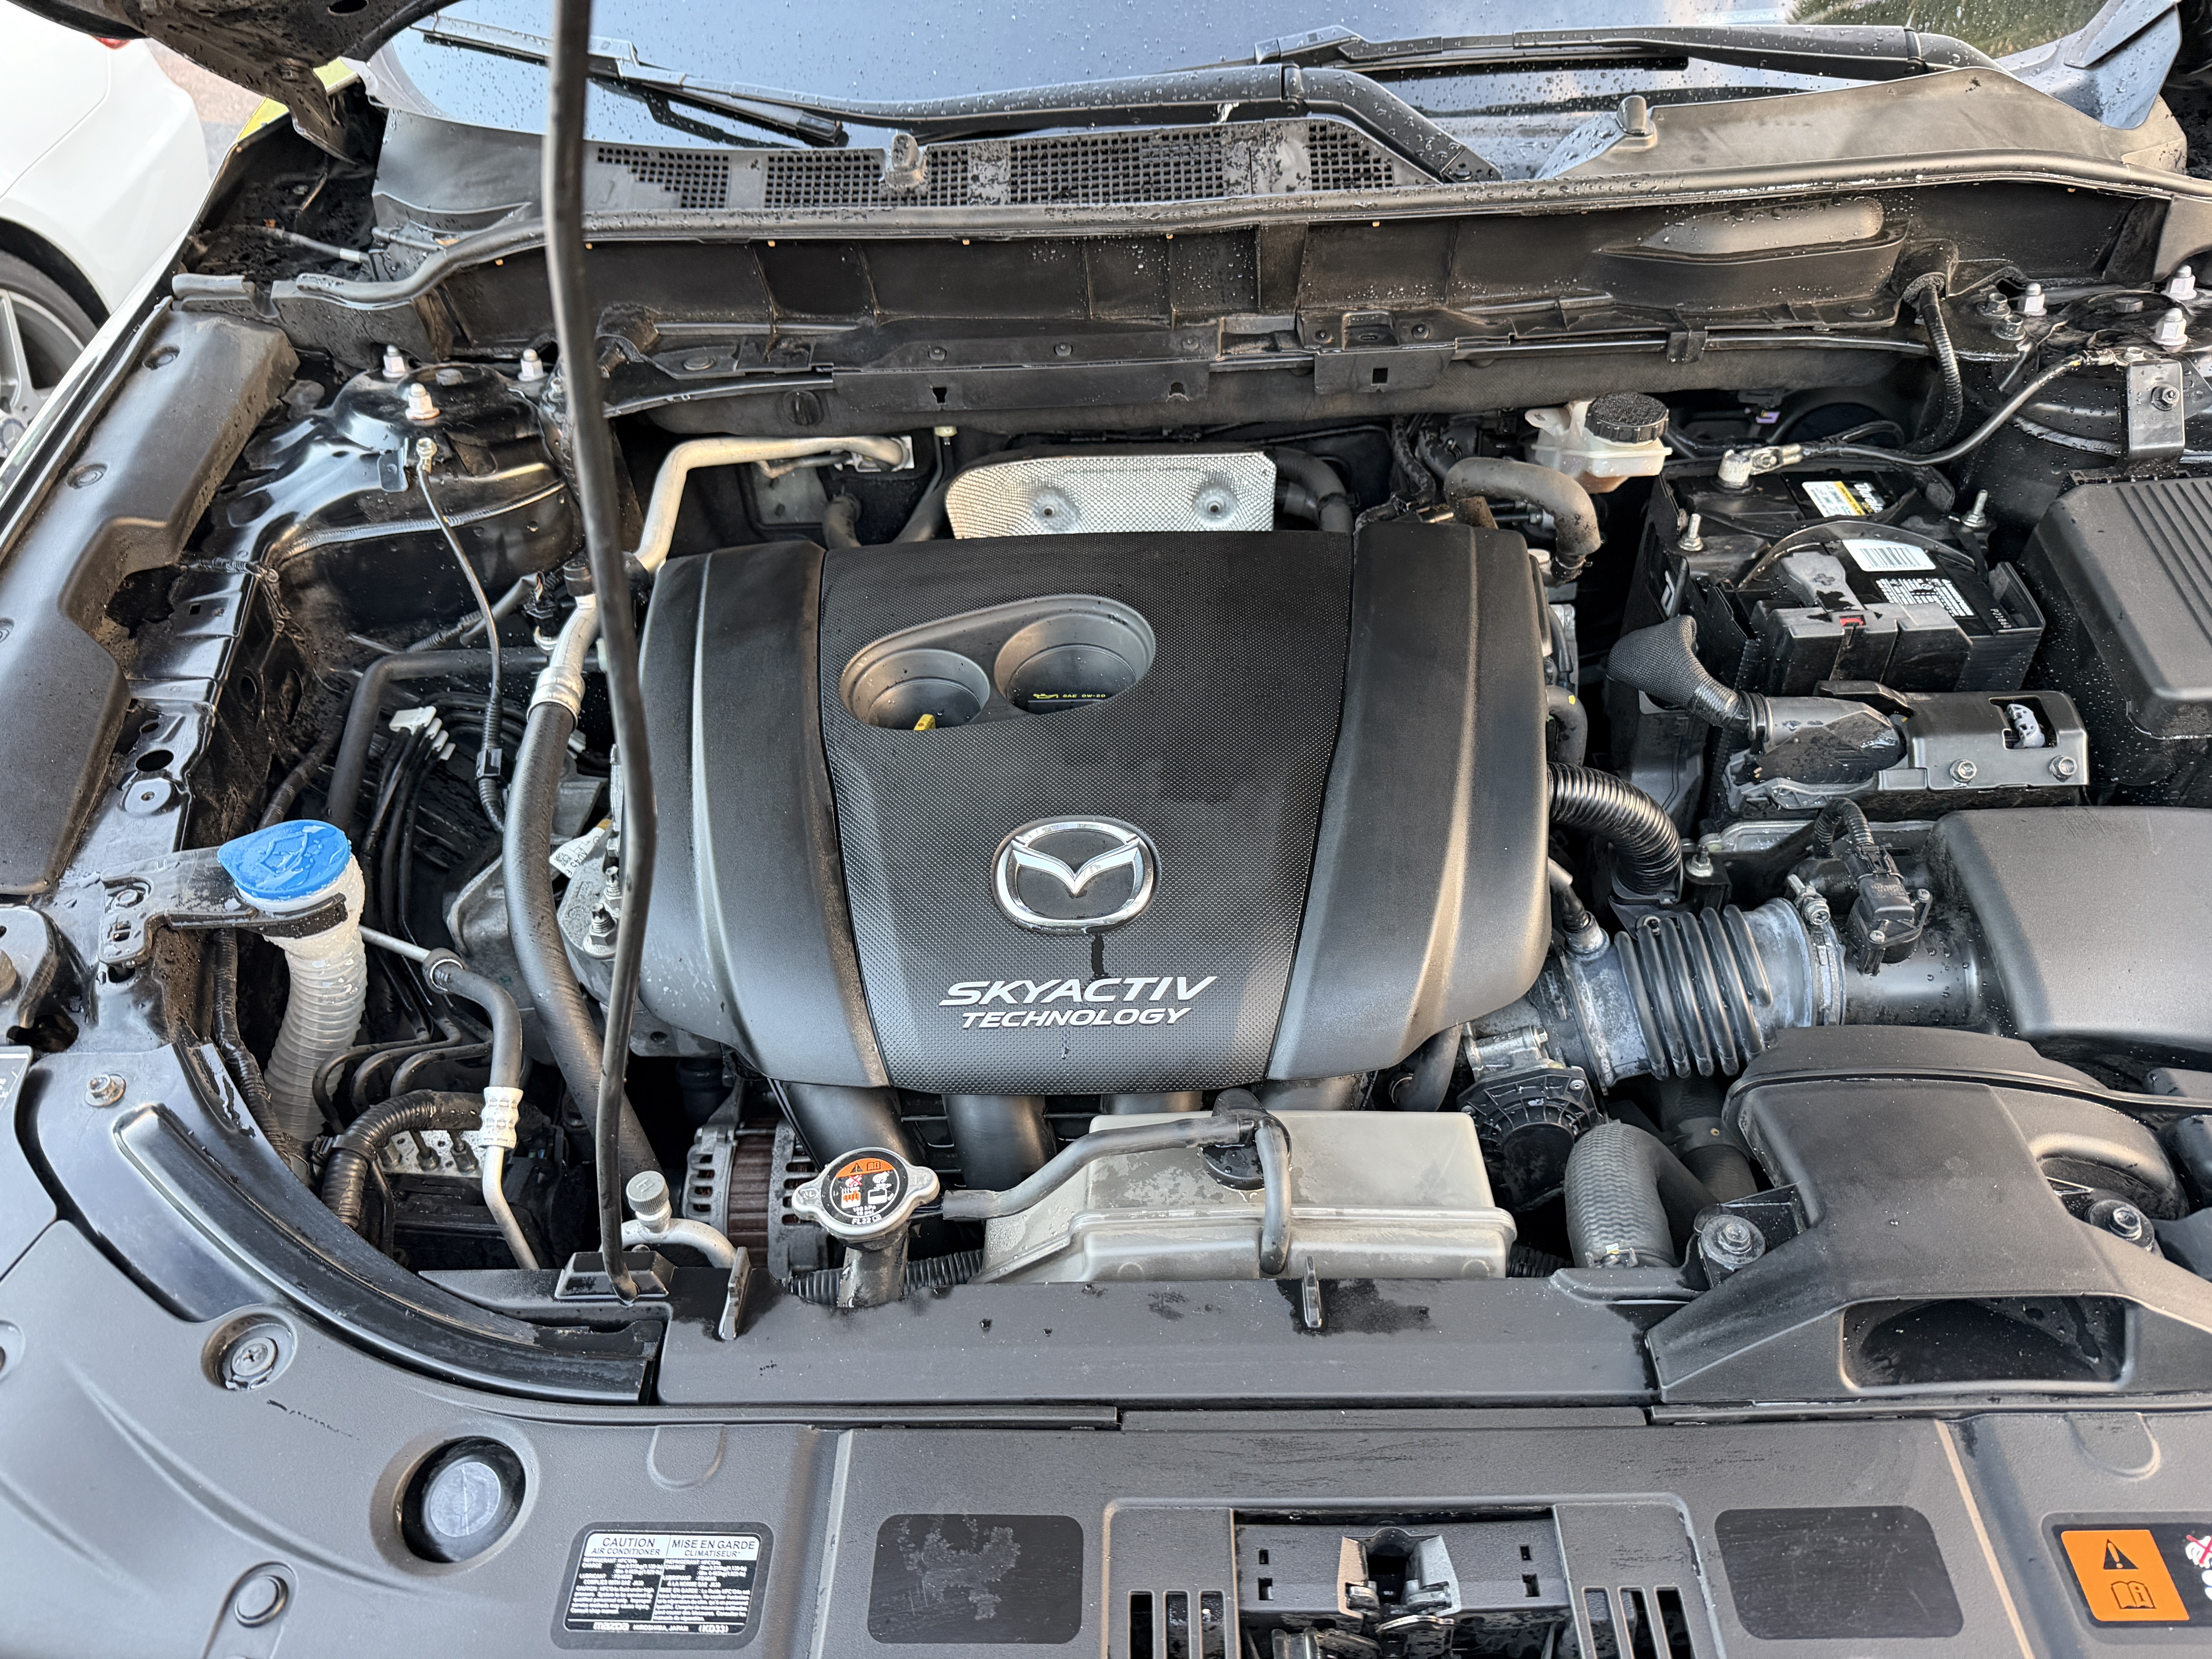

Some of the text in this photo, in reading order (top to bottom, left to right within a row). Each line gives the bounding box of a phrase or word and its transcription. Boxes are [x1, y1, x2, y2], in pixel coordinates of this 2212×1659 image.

[939, 976, 1218, 1006] SKYACTIV
[962, 1007, 1192, 1029] TECHNOLOGY
[852, 1217, 871, 1225] FL22
[603, 1537, 655, 1547] CAUTION
[672, 1540, 756, 1550] MISE EN GARDE
[607, 1548, 661, 1556] CONDITIONER
[593, 1621, 630, 1631] mazda
